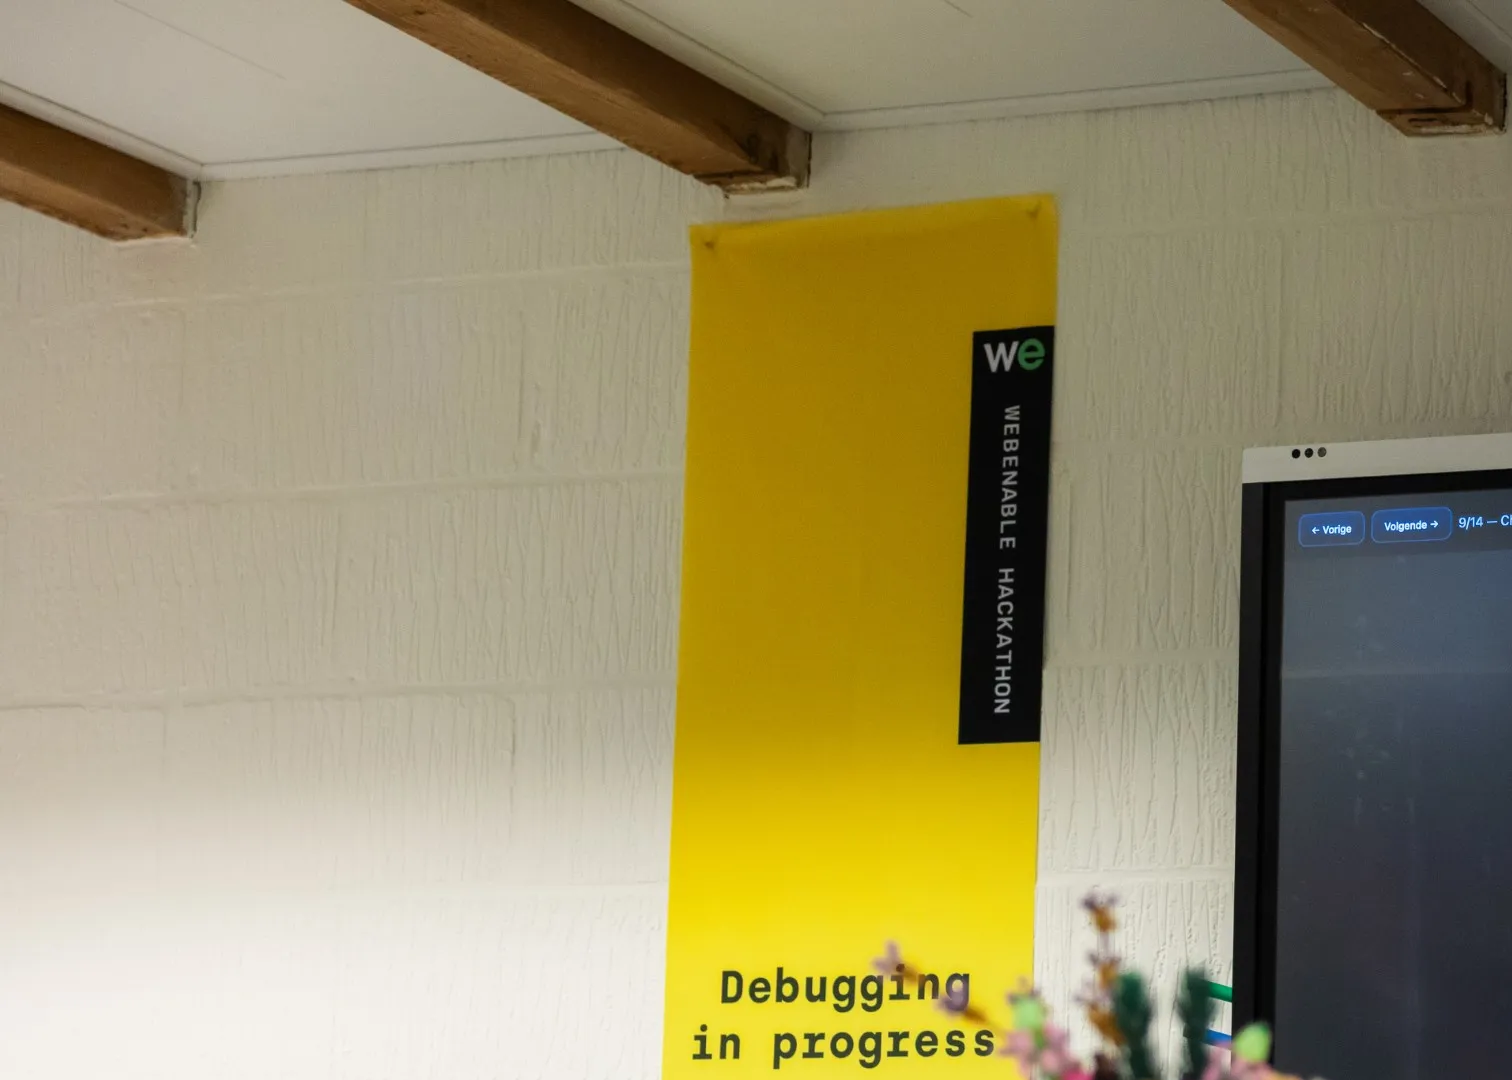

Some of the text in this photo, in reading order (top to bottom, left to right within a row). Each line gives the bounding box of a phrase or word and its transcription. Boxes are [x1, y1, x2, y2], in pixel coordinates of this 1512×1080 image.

[984, 338, 1045, 373] we
[1322, 524, 1352, 537] Vorige
[1384, 520, 1427, 532] Volgende
[1459, 517, 1483, 530] 9/14
[994, 405, 1020, 714] WEBENABLE HACKATHON
[721, 966, 969, 1012] Debugging
[692, 1024, 994, 1069] in progress
